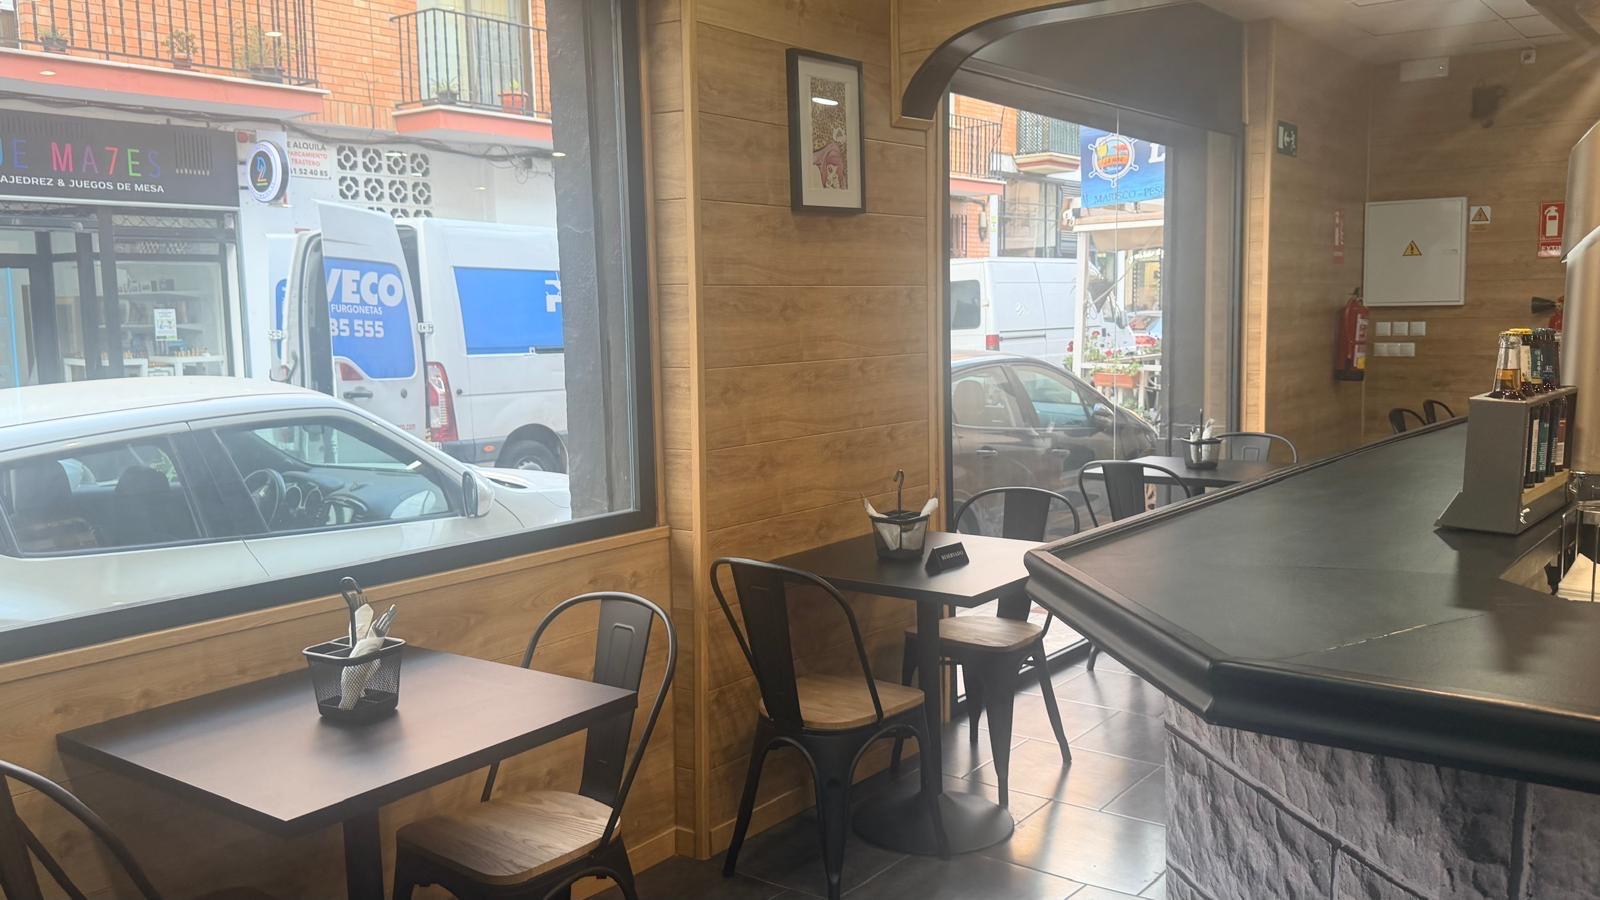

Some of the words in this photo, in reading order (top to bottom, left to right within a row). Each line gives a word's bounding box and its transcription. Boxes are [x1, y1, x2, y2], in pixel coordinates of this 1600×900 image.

[293, 141, 327, 151] ALQUILA
[51, 142, 161, 178] MA7ES
[0, 175, 54, 187] AJEDREZ
[58, 179, 65, 187] &
[69, 179, 114, 191] JUEGOS
[117, 183, 131, 191] DE
[134, 184, 165, 193] MESA
[331, 304, 383, 315] FURGONETAS
[354, 320, 384, 338] 555
